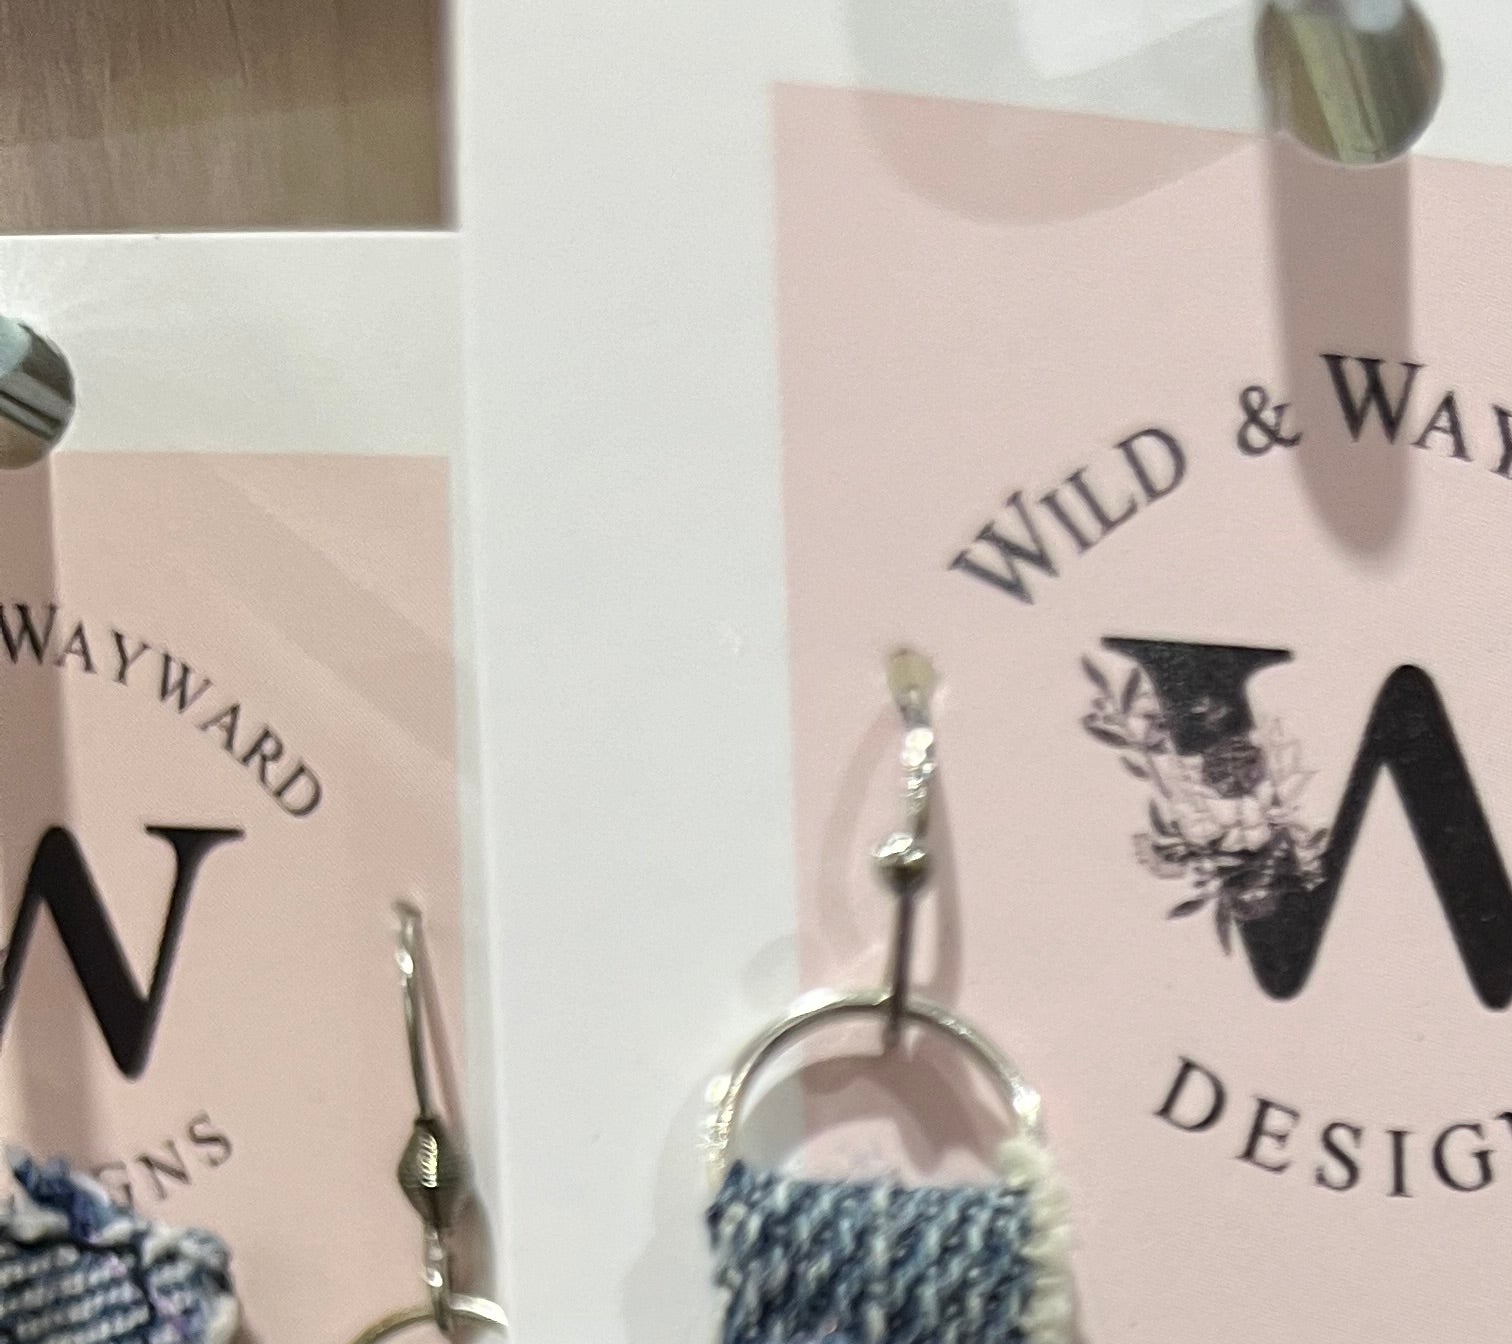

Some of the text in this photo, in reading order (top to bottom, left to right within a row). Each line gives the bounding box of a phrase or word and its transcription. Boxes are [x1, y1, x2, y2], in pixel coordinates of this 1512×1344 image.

[947, 426, 1190, 606] WILD
[1235, 385, 1302, 457] &
[0, 602, 323, 819] WAYWARD
